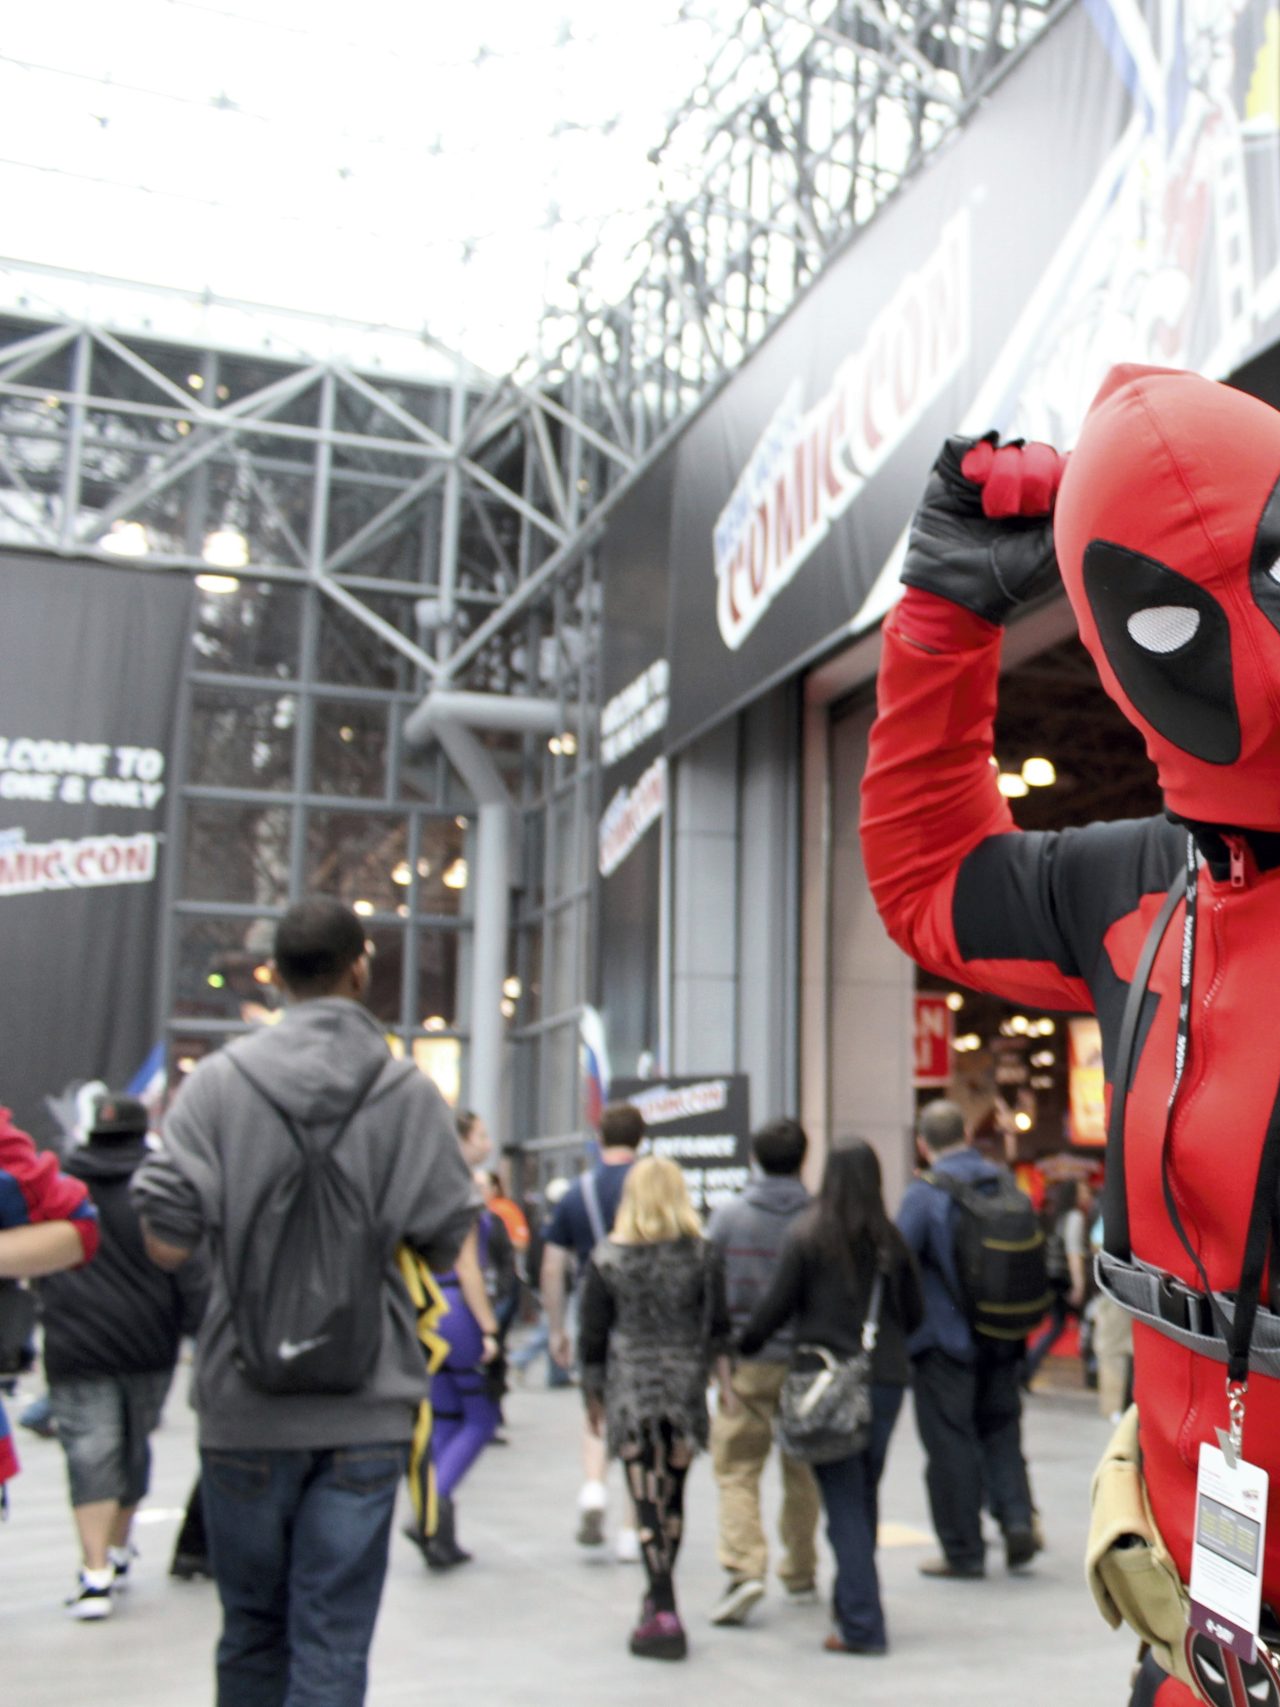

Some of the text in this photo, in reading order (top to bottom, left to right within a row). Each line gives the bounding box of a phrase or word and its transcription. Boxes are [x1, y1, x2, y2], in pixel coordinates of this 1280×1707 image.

[729, 393, 848, 626] COMIC
[115, 746, 164, 781] TO
[74, 845, 149, 877] CON
